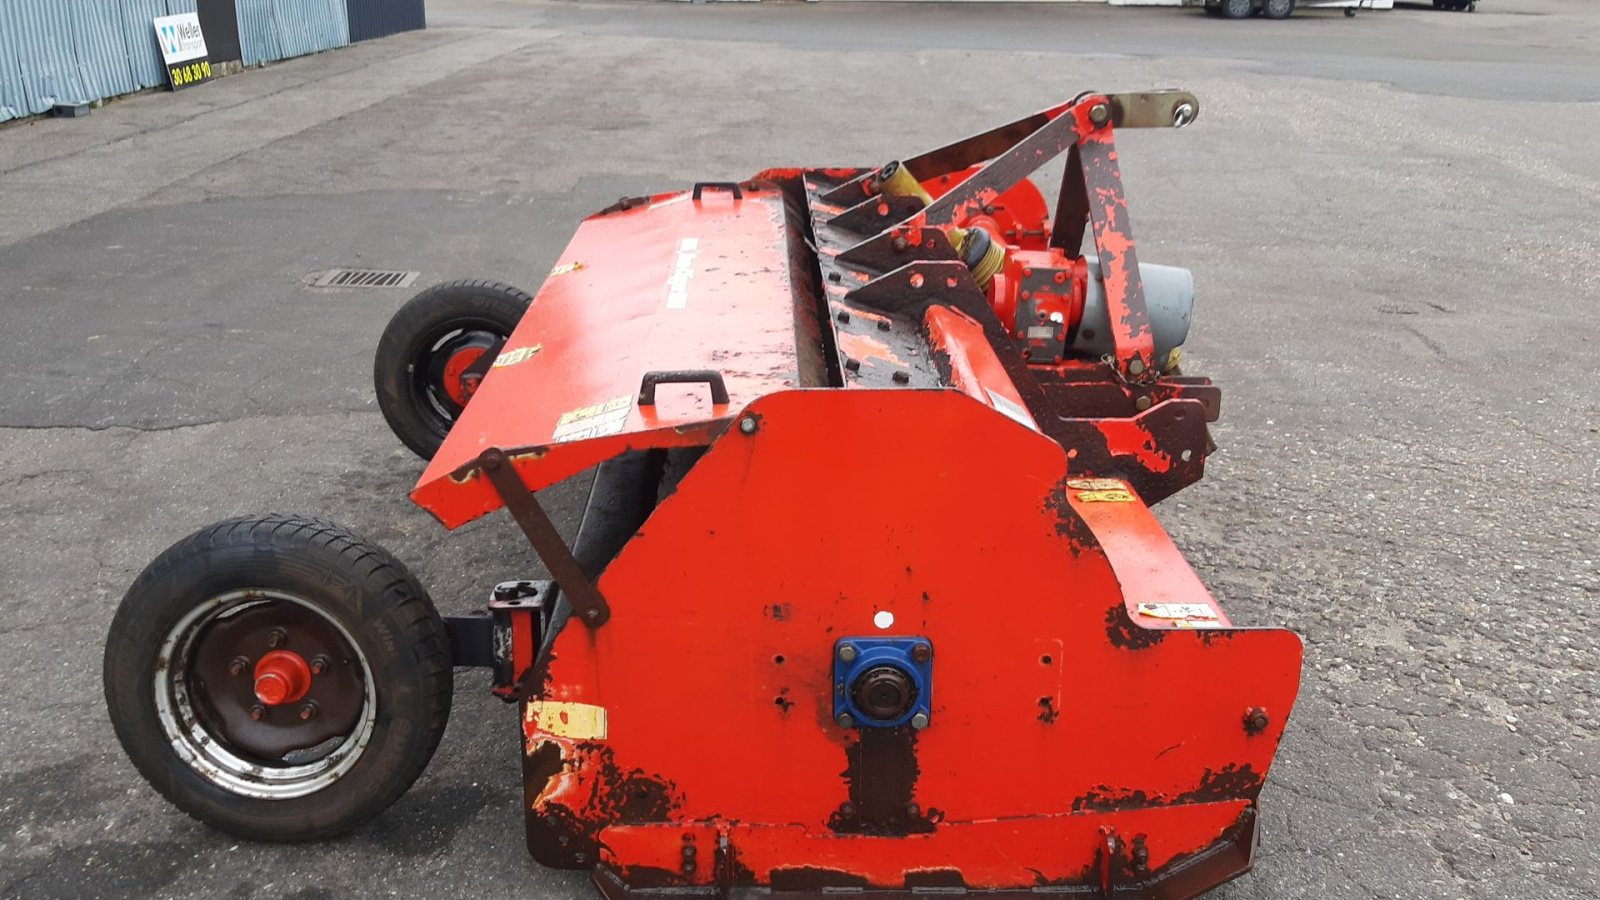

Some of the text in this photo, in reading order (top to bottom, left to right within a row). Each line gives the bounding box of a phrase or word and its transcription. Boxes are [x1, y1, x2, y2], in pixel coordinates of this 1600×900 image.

[177, 22, 201, 40] Weller
[171, 60, 212, 86] 30 68 30 90
